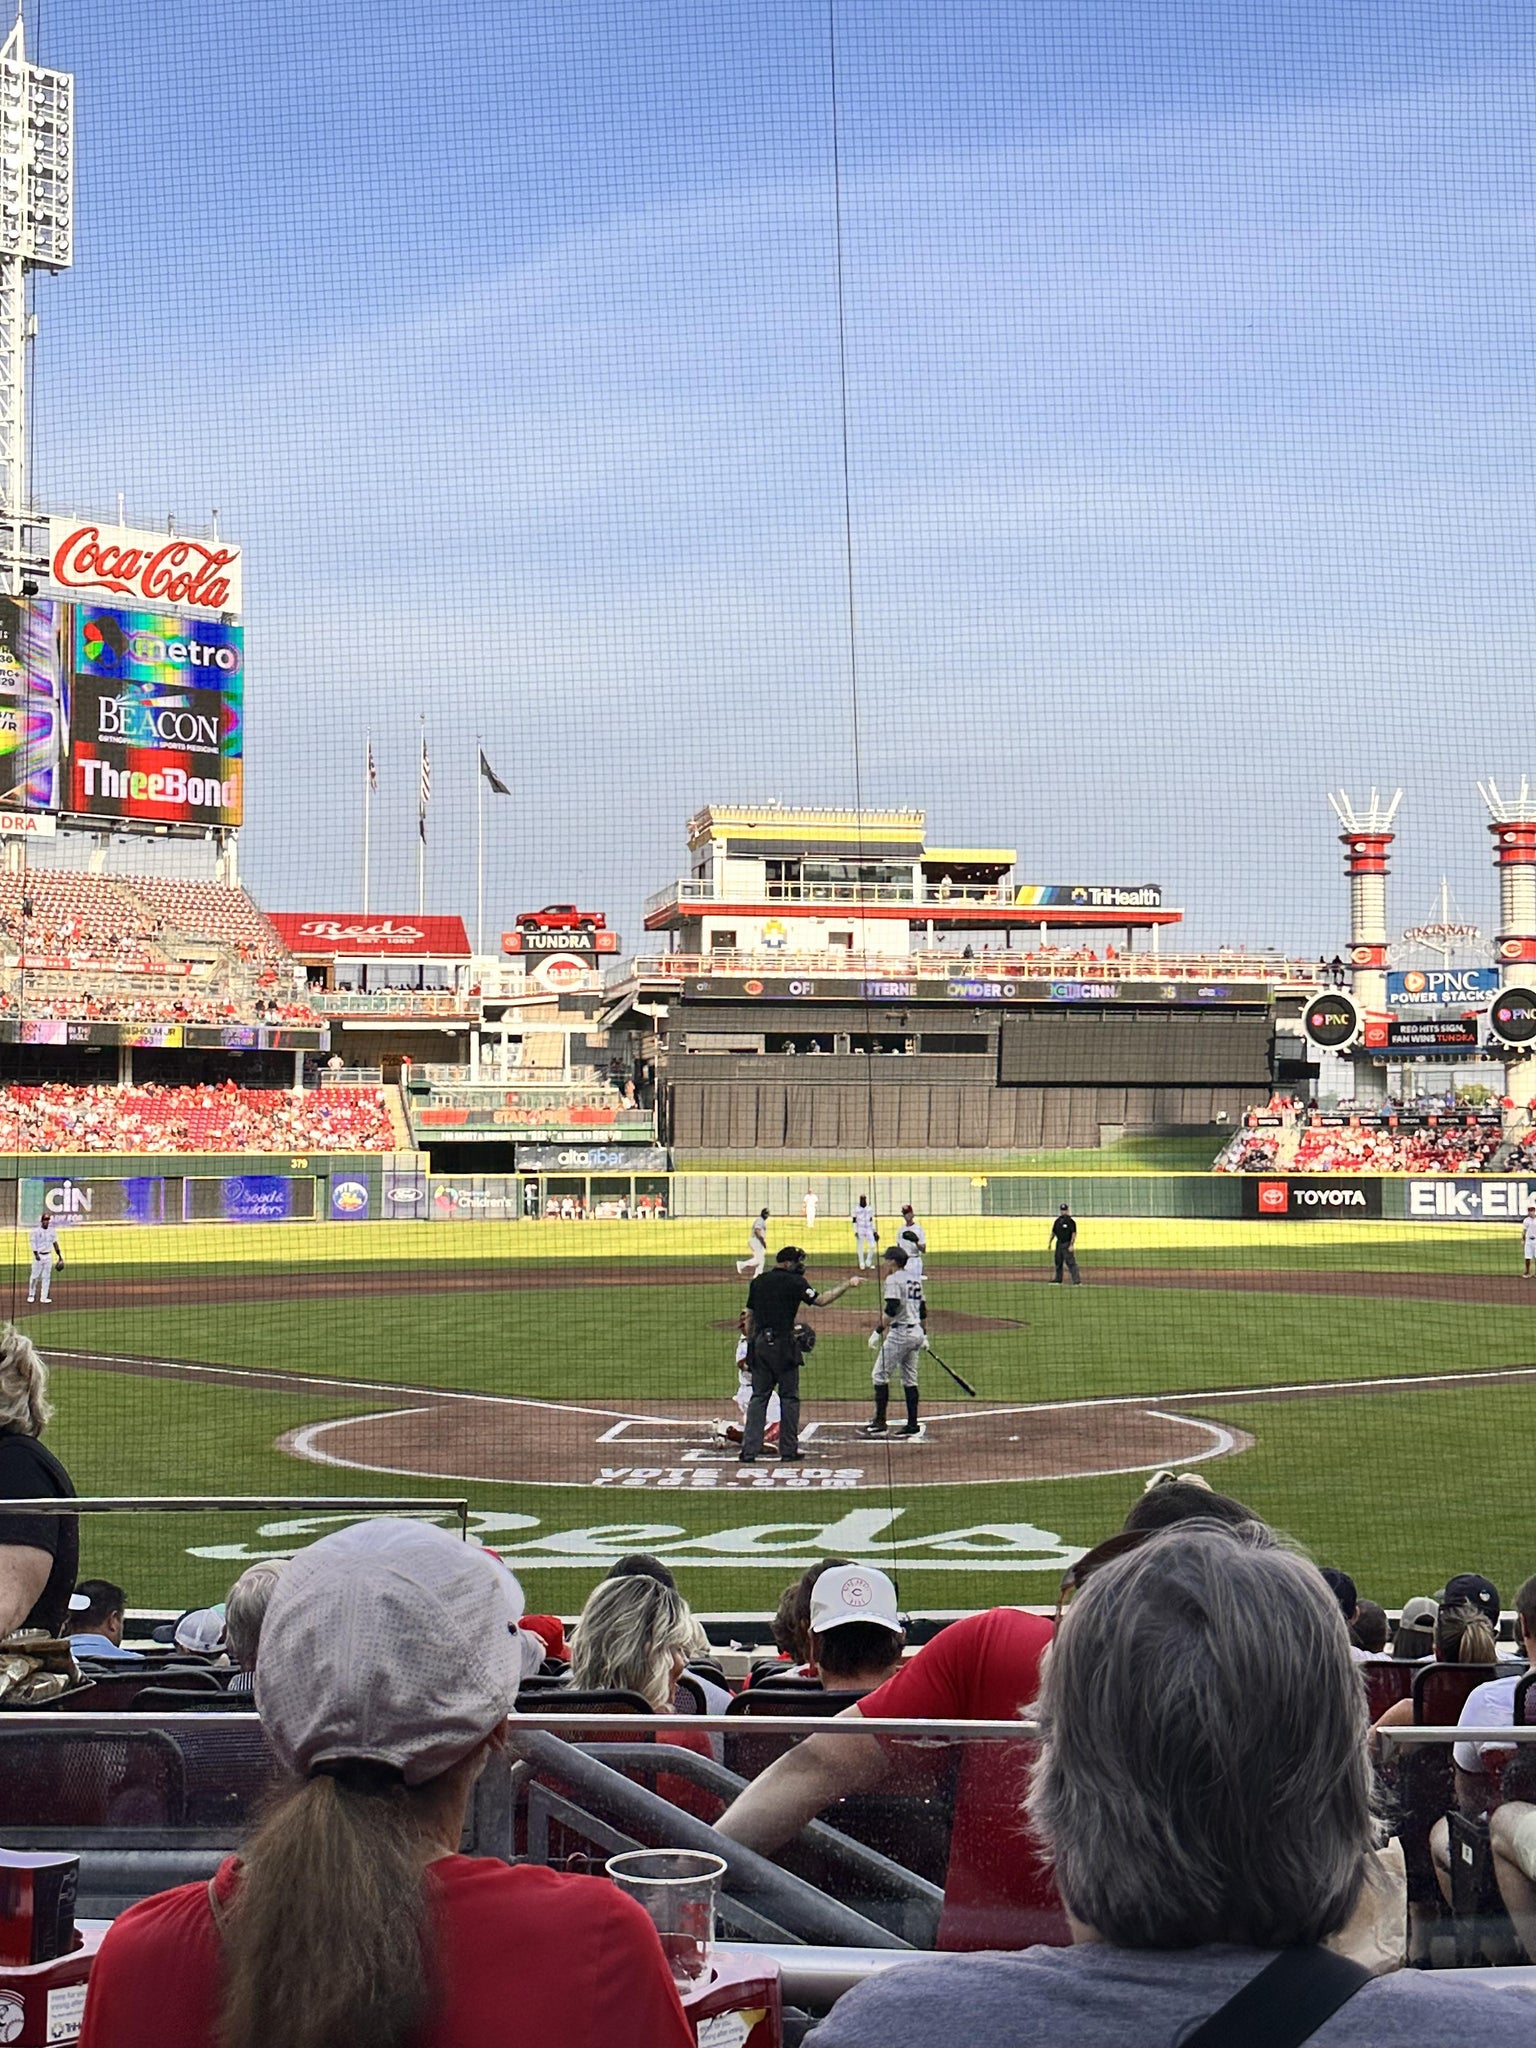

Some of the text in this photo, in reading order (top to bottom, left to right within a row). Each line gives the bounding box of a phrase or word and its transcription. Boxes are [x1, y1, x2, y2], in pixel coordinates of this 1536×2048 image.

[53, 526, 240, 608] Coca-Cola
[98, 696, 219, 744] BEACON
[77, 758, 238, 808] ThreeBond
[1088, 887, 1160, 906] TriHealth
[298, 920, 425, 941] Reds
[526, 935, 591, 949] TUNDRA
[1426, 971, 1480, 992] PNC
[1391, 989, 1494, 1003] POWER STACKS
[1325, 1014, 1350, 1026] PNC
[1400, 1025, 1419, 1034] RED
[1420, 1024, 1439, 1033] HITS
[1392, 1036, 1411, 1044] FAN
[1412, 1035, 1436, 1043] WINS
[290, 1159, 308, 1169] 379
[557, 1149, 625, 1165] altafiber
[459, 1197, 512, 1208] Children's
[1294, 1190, 1366, 1206] TOYOTA
[907, 1280, 922, 1300] 22
[600, 1468, 864, 1479] VOTE REDS
